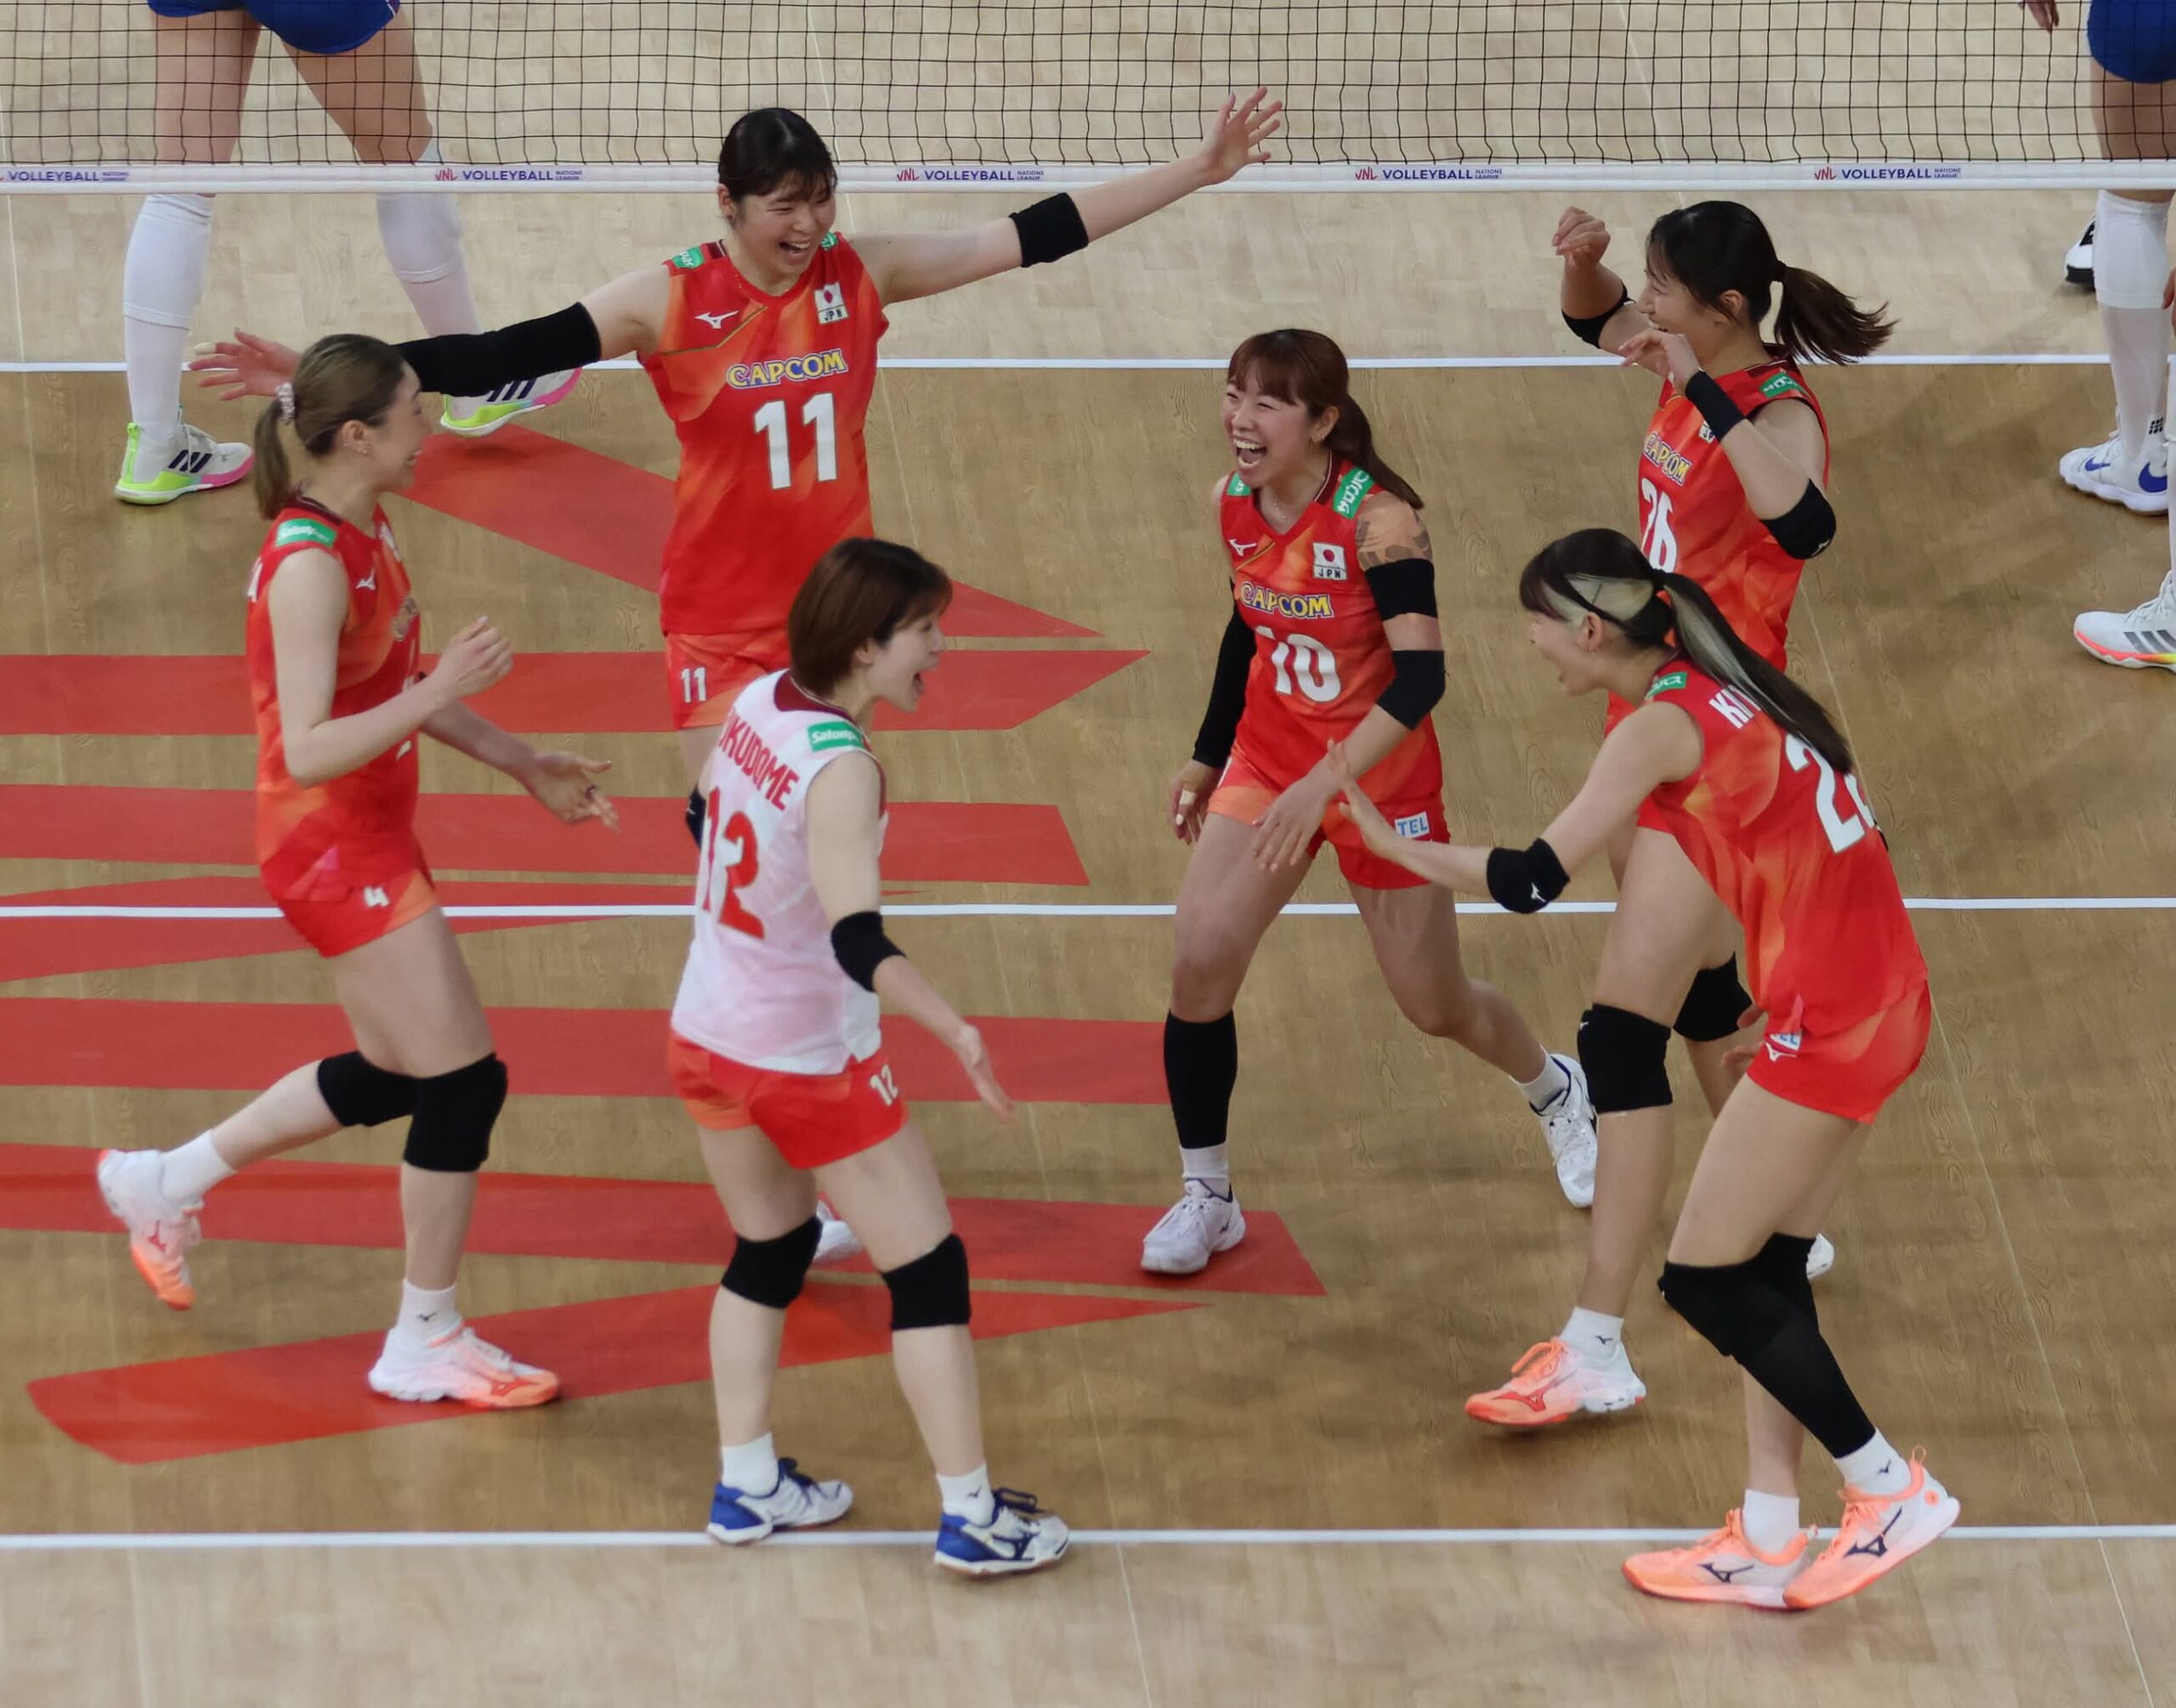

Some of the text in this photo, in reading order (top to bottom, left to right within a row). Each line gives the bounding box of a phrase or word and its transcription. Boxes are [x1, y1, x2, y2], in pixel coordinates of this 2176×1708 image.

[8, 171, 99, 181] VOLLEYBALL
[462, 170, 554, 180] VOLLEYBALL
[925, 170, 1014, 180] VOLLEYBALL
[1383, 169, 1473, 179] VOLLEYBALL
[1842, 168, 1931, 178] VOLLEYBALL
[824, 308, 842, 321] JPN
[726, 348, 848, 389] CAPCOM
[754, 393, 837, 490] 11
[1642, 431, 1692, 487] CAPCOM
[1318, 568, 1341, 579] JPN
[1240, 581, 1334, 619] CAPCOM
[1254, 625, 1342, 703] 10
[681, 667, 706, 704] 11
[1397, 817, 1428, 837] TEL
[702, 785, 765, 941] 12
[364, 885, 390, 908] 4
[870, 1063, 898, 1106] 12
